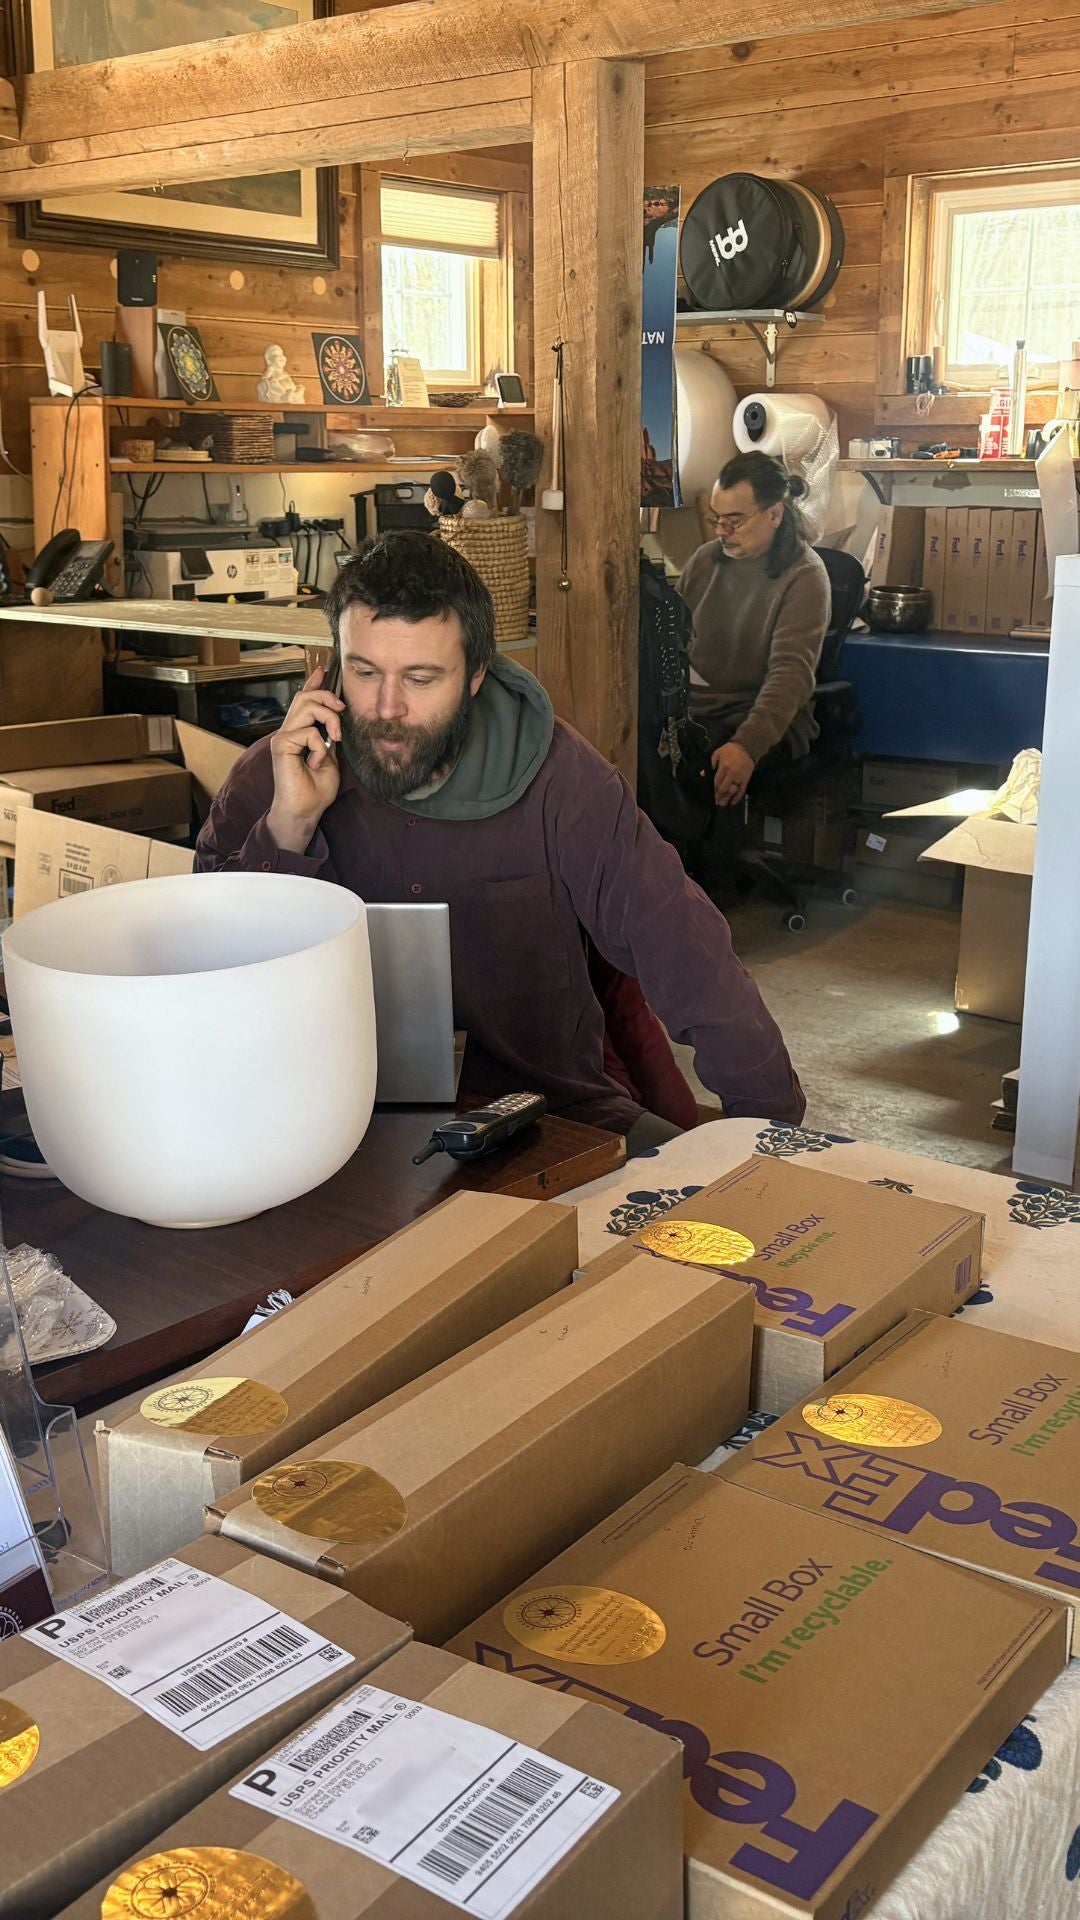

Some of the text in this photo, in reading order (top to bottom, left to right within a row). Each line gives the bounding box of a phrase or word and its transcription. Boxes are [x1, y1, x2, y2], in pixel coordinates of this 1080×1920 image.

[754, 1231, 799, 1261] Small
[785, 1213, 825, 1234] Box
[777, 1231, 837, 1268] Recycle me.
[968, 1398, 1037, 1446] Small
[1013, 1373, 1069, 1402] Box
[1010, 1434, 1051, 1456] I'm
[35, 1618, 66, 1640] P
[57, 1627, 97, 1649] USPS
[95, 1596, 156, 1629] PRIORITY
[158, 1580, 189, 1598] MAIL
[692, 1595, 785, 1667] Small
[761, 1557, 834, 1602] Box
[737, 1559, 894, 1685] I'm recyclable.
[181, 1663, 203, 1676] USPS
[203, 1641, 243, 1664] TRACKING
[201, 1700, 220, 1713] 9405
[243, 1769, 277, 1797] P
[279, 1778, 315, 1807] USPS
[313, 1733, 369, 1779] PRIORITY
[366, 1711, 398, 1735] MAIL
[435, 1814, 457, 1833] USPS
[454, 1783, 490, 1815] TRACKING
